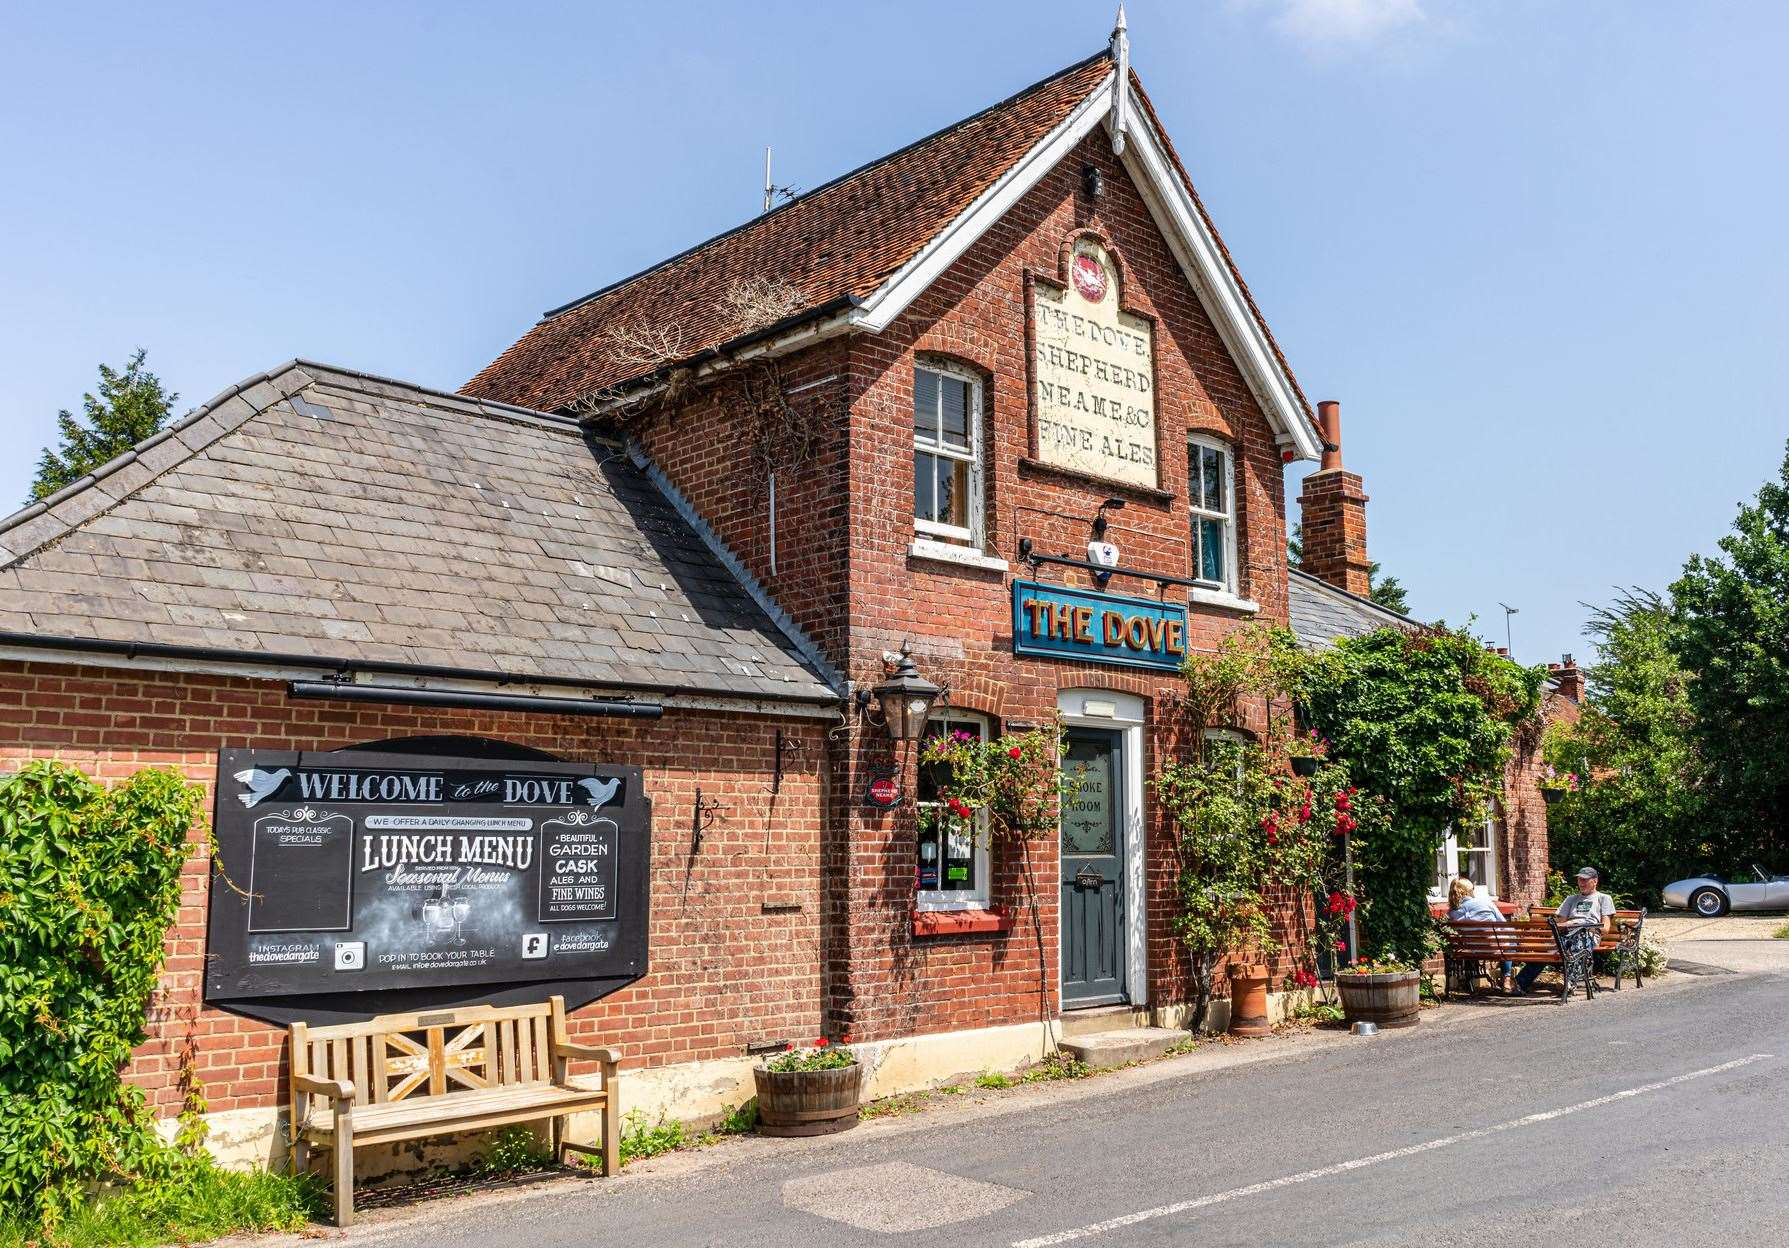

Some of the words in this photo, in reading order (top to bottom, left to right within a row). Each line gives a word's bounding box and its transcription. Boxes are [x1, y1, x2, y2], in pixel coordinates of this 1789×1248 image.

[1036, 342, 1150, 393] SHEPHERD
[1039, 380, 1122, 421] NEAME
[1039, 418, 1093, 452] FINE
[1098, 435, 1153, 466] ALES
[1023, 598, 1095, 644] THE
[1103, 609, 1185, 657] DOVE
[297, 772, 444, 801] WELCOME
[454, 784, 472, 798] to
[473, 779, 499, 795] the
[503, 779, 574, 804] DOVE
[393, 818, 420, 826] OFFER
[421, 818, 428, 826] A
[428, 818, 450, 826] DAILY
[507, 819, 526, 827] MENU
[266, 826, 291, 834] TODAYS
[291, 826, 305, 835] PUB
[305, 826, 333, 835] CLASSIC
[560, 834, 598, 842] BEAUTIFUL
[280, 835, 322, 843] SPECIALS
[361, 835, 454, 872] LUNCH
[458, 836, 534, 870] MENU
[549, 844, 608, 856] GARDEN
[385, 863, 461, 885] Seasonal
[455, 866, 511, 884] Menus
[555, 859, 598, 874] CASK
[550, 876, 574, 885] ALES
[578, 875, 598, 884] AND
[551, 887, 573, 901] FINE
[575, 886, 605, 900] WINES
[549, 904, 560, 912] ALL
[561, 931, 602, 942] facebook
[258, 944, 320, 953] INSTAGRAM
[379, 954, 397, 964] POP
[397, 953, 408, 962] IN
[409, 952, 420, 961] TO
[420, 951, 444, 961] BOOK
[445, 951, 467, 960] YOUR
[470, 949, 496, 958] TABLE
